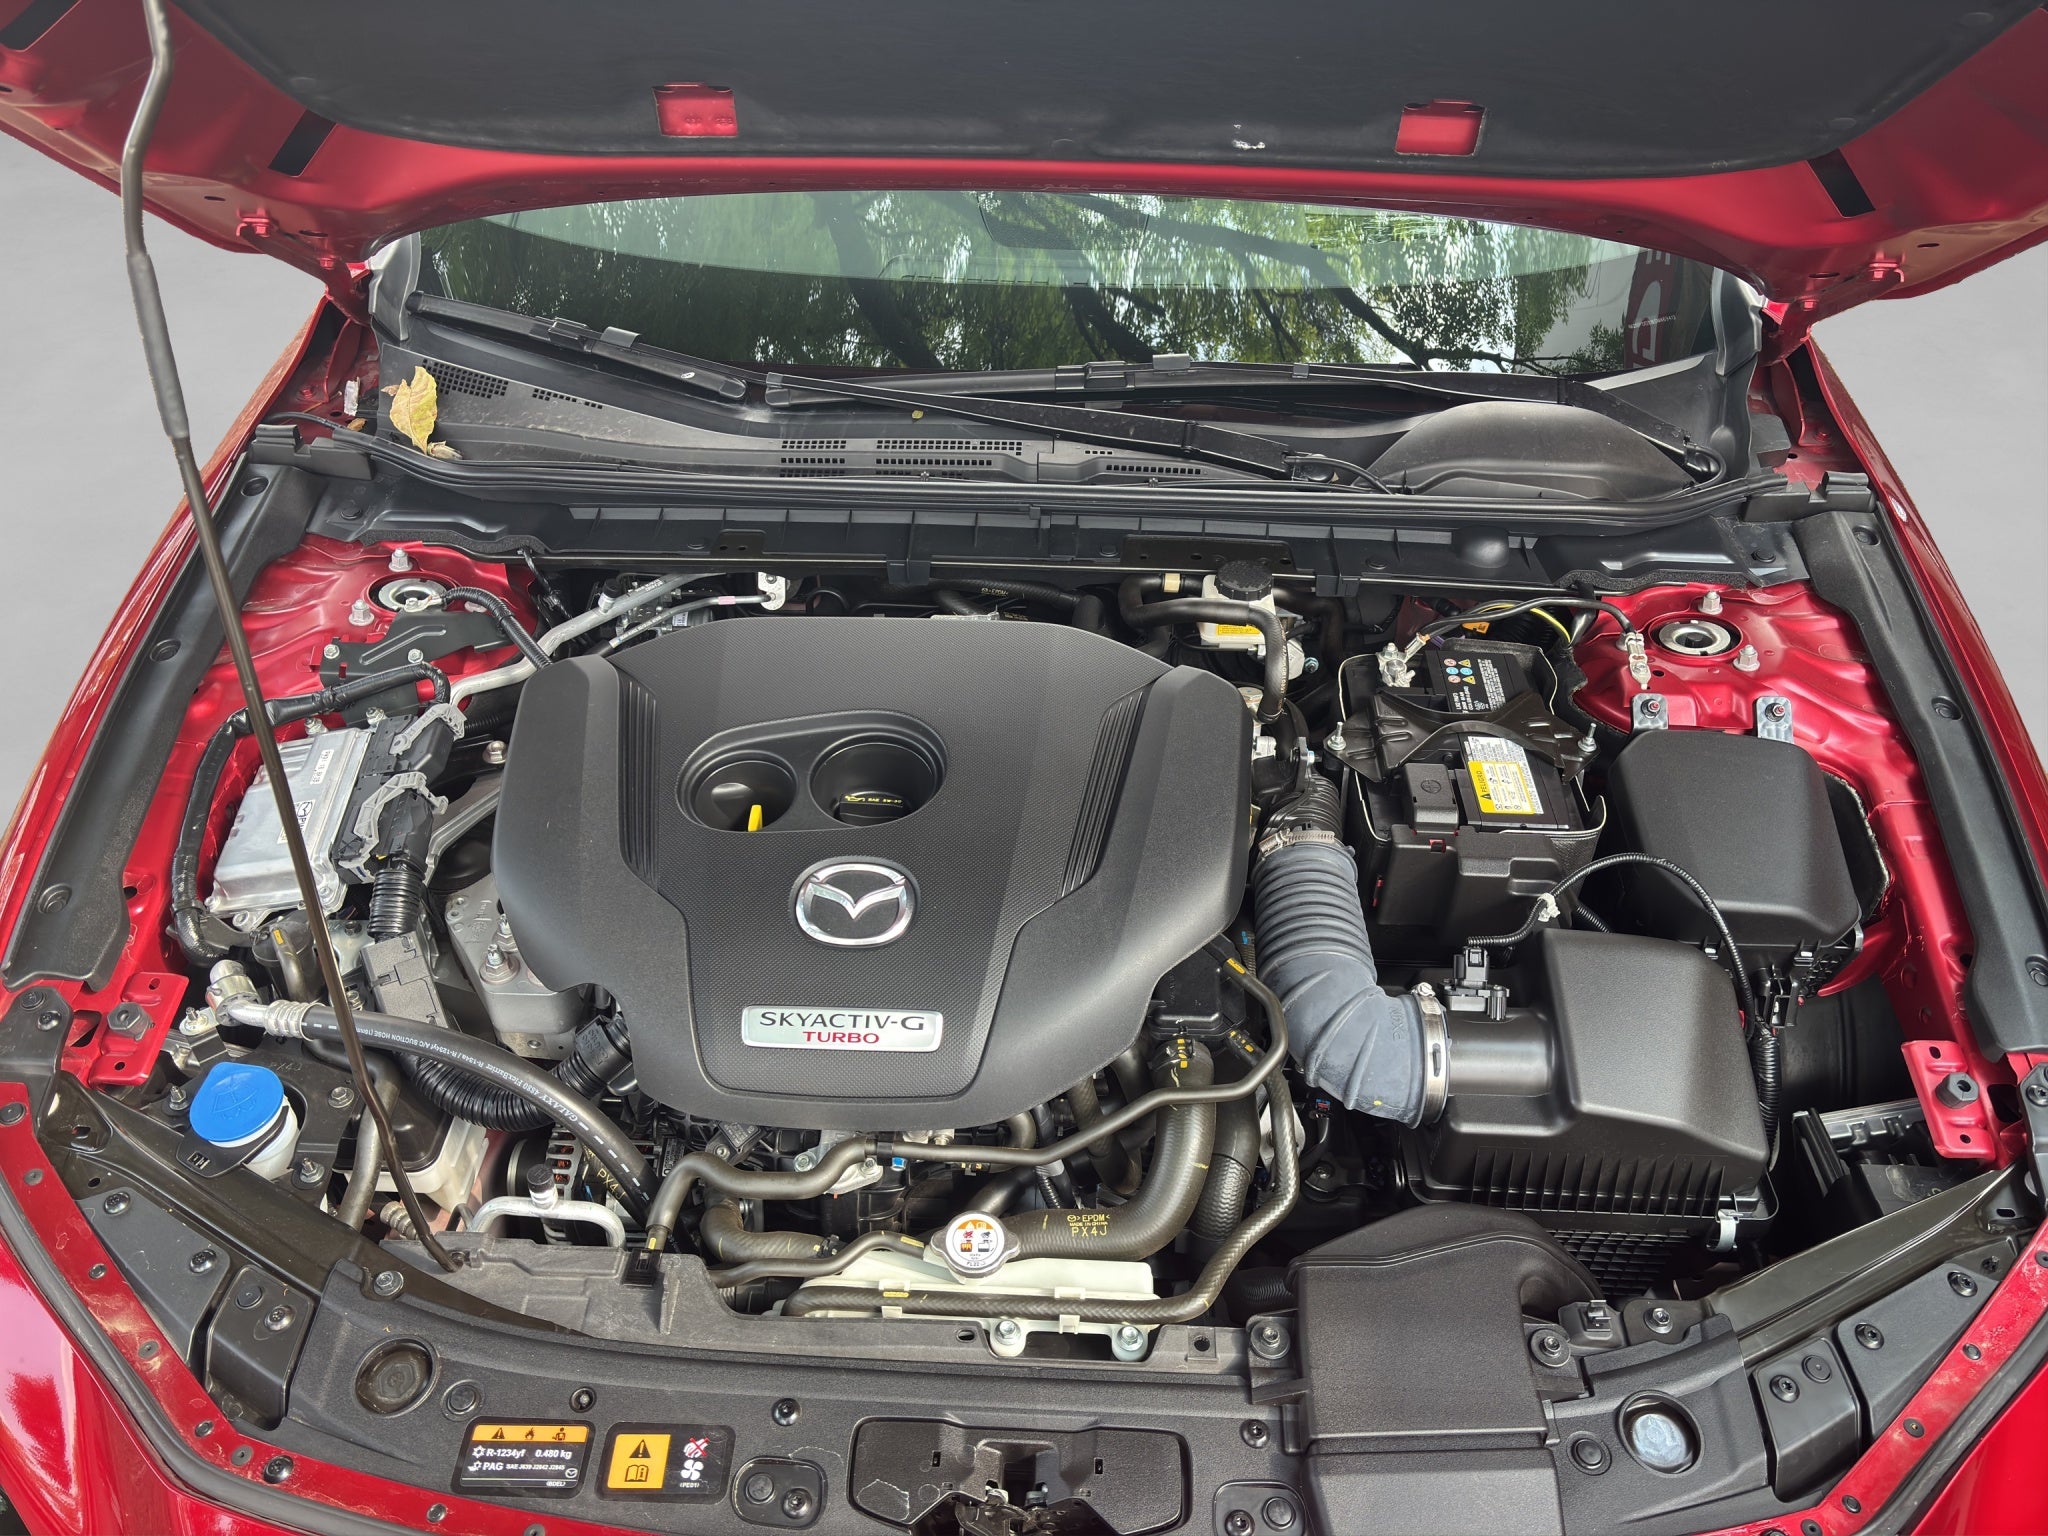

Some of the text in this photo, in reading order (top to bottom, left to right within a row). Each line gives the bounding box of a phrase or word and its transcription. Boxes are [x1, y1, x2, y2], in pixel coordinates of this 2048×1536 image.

[759, 1011, 925, 1031] SKYACTIV-G
[374, 1030, 391, 1039] HOSE
[391, 1034, 418, 1045] SUCTION
[802, 1031, 880, 1044] TURBO
[418, 1039, 430, 1048] A/C
[430, 1041, 458, 1057] R-1234yf
[461, 1053, 484, 1068] R-134a
[486, 1063, 523, 1087] FlexBarrier
[539, 1093, 578, 1122] GALAXY
[597, 1168, 628, 1199] PX4J
[1071, 1225, 1107, 1237] PX4J
[486, 1448, 573, 1460] R-1234yf 0.480 kg
[482, 1462, 504, 1471] PAG
